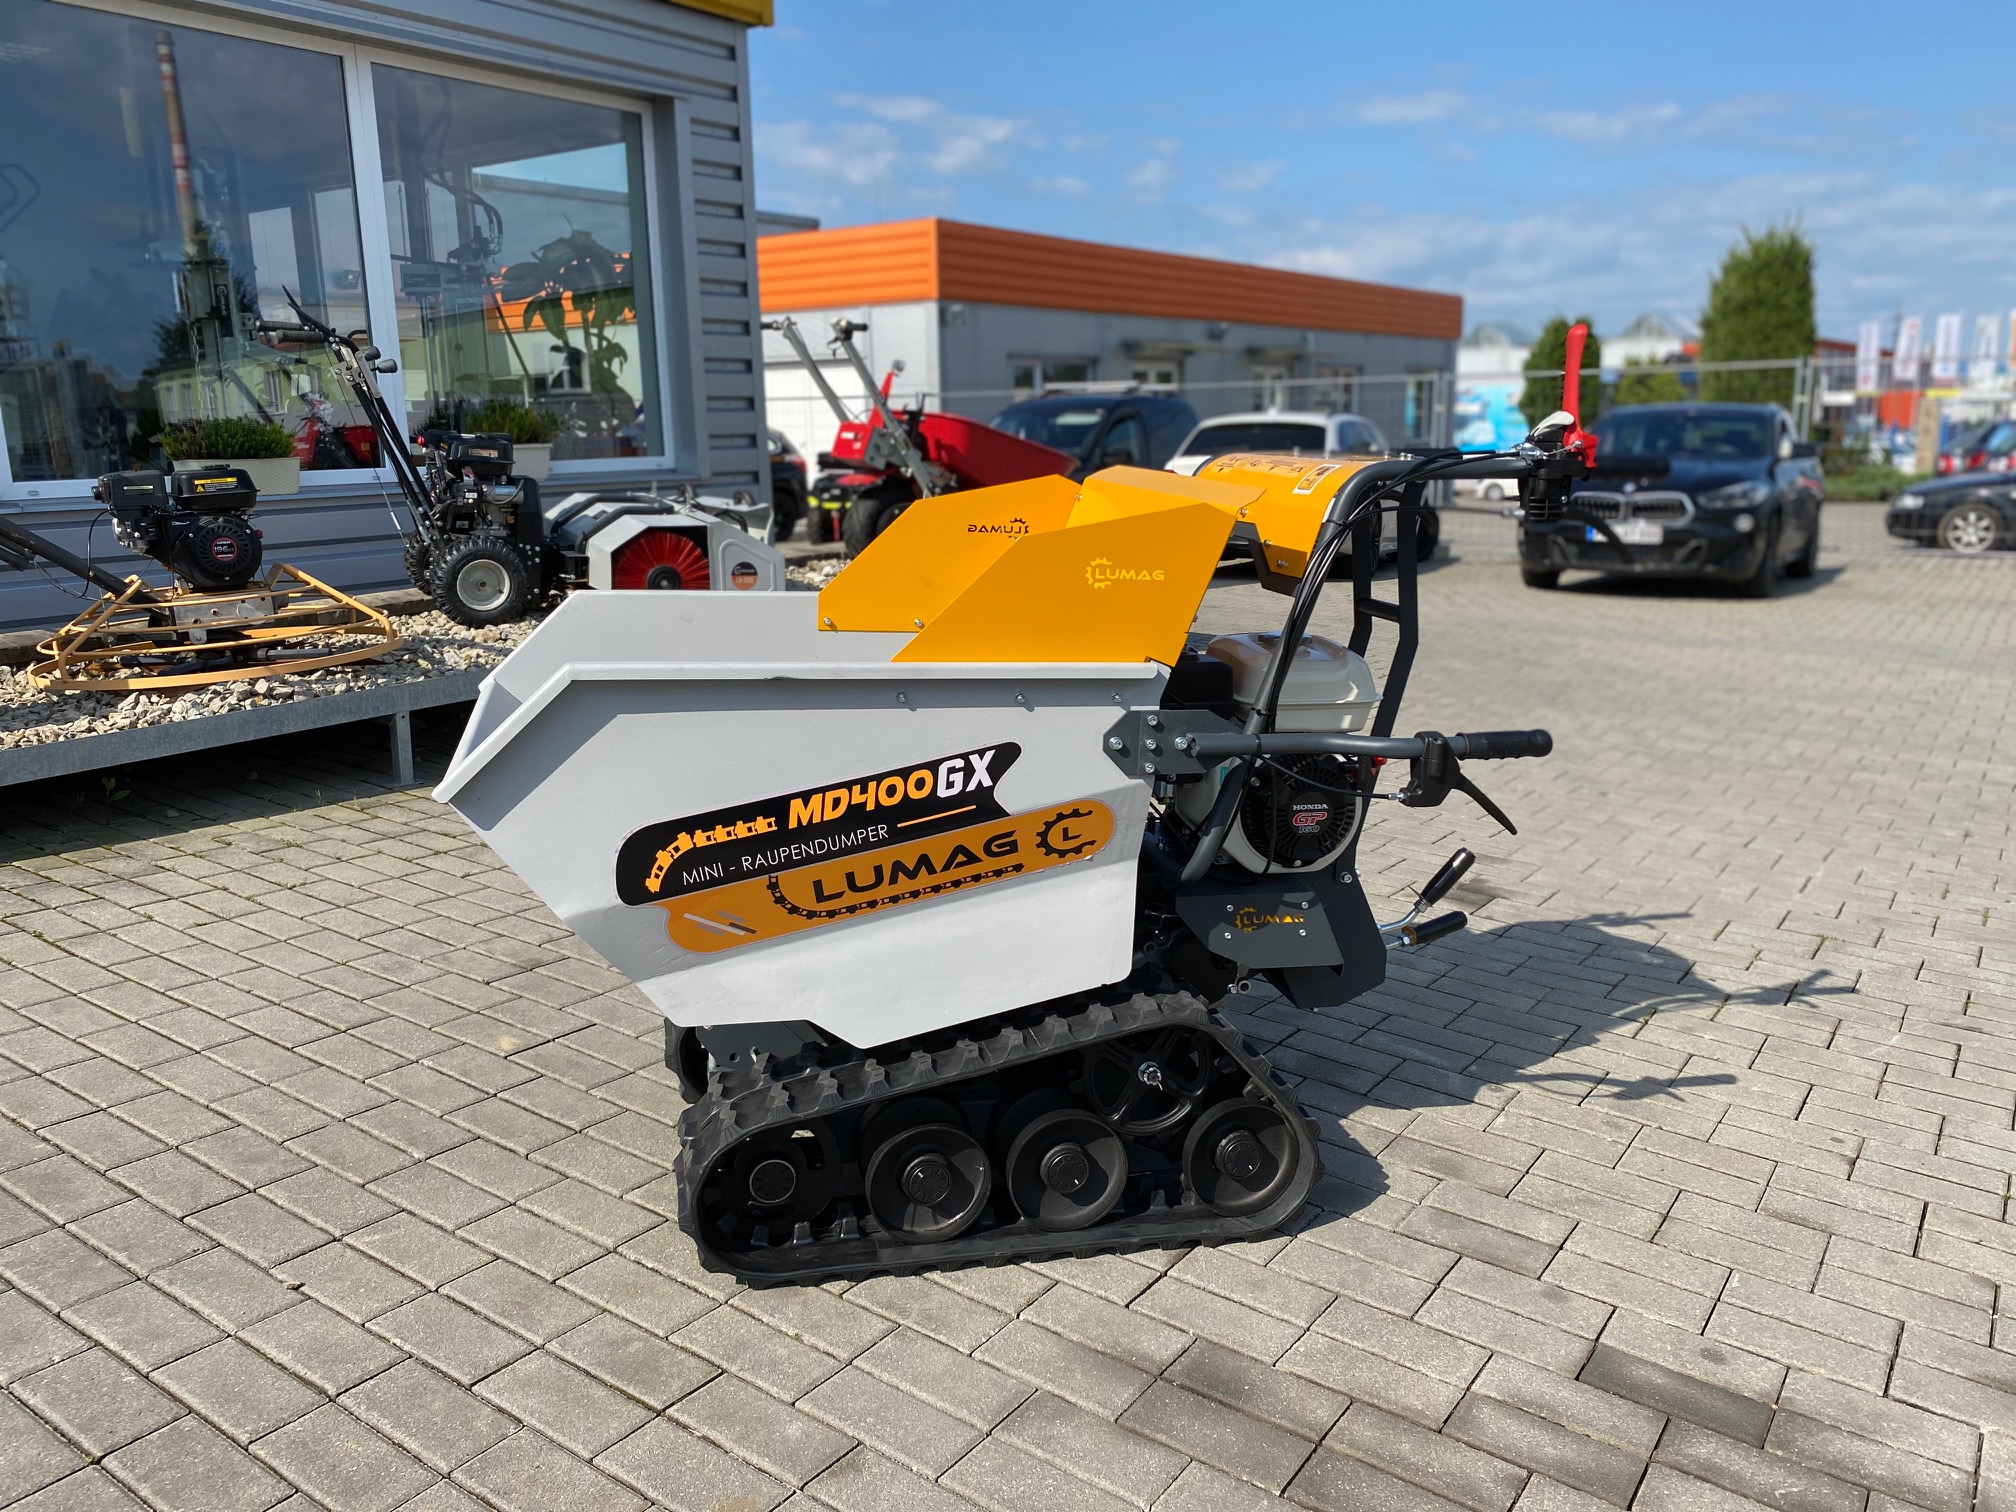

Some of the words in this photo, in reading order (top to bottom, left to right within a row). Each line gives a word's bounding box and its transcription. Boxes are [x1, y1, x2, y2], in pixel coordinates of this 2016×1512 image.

[1095, 567, 1165, 581] LUMAG
[788, 750, 996, 830] MD400GX
[1292, 803, 1329, 811] HONDA
[1292, 811, 1328, 827] GP
[683, 862, 724, 886] MINI
[741, 824, 889, 872] RAUPENDUMPER
[812, 829, 1019, 905] LUMAG
